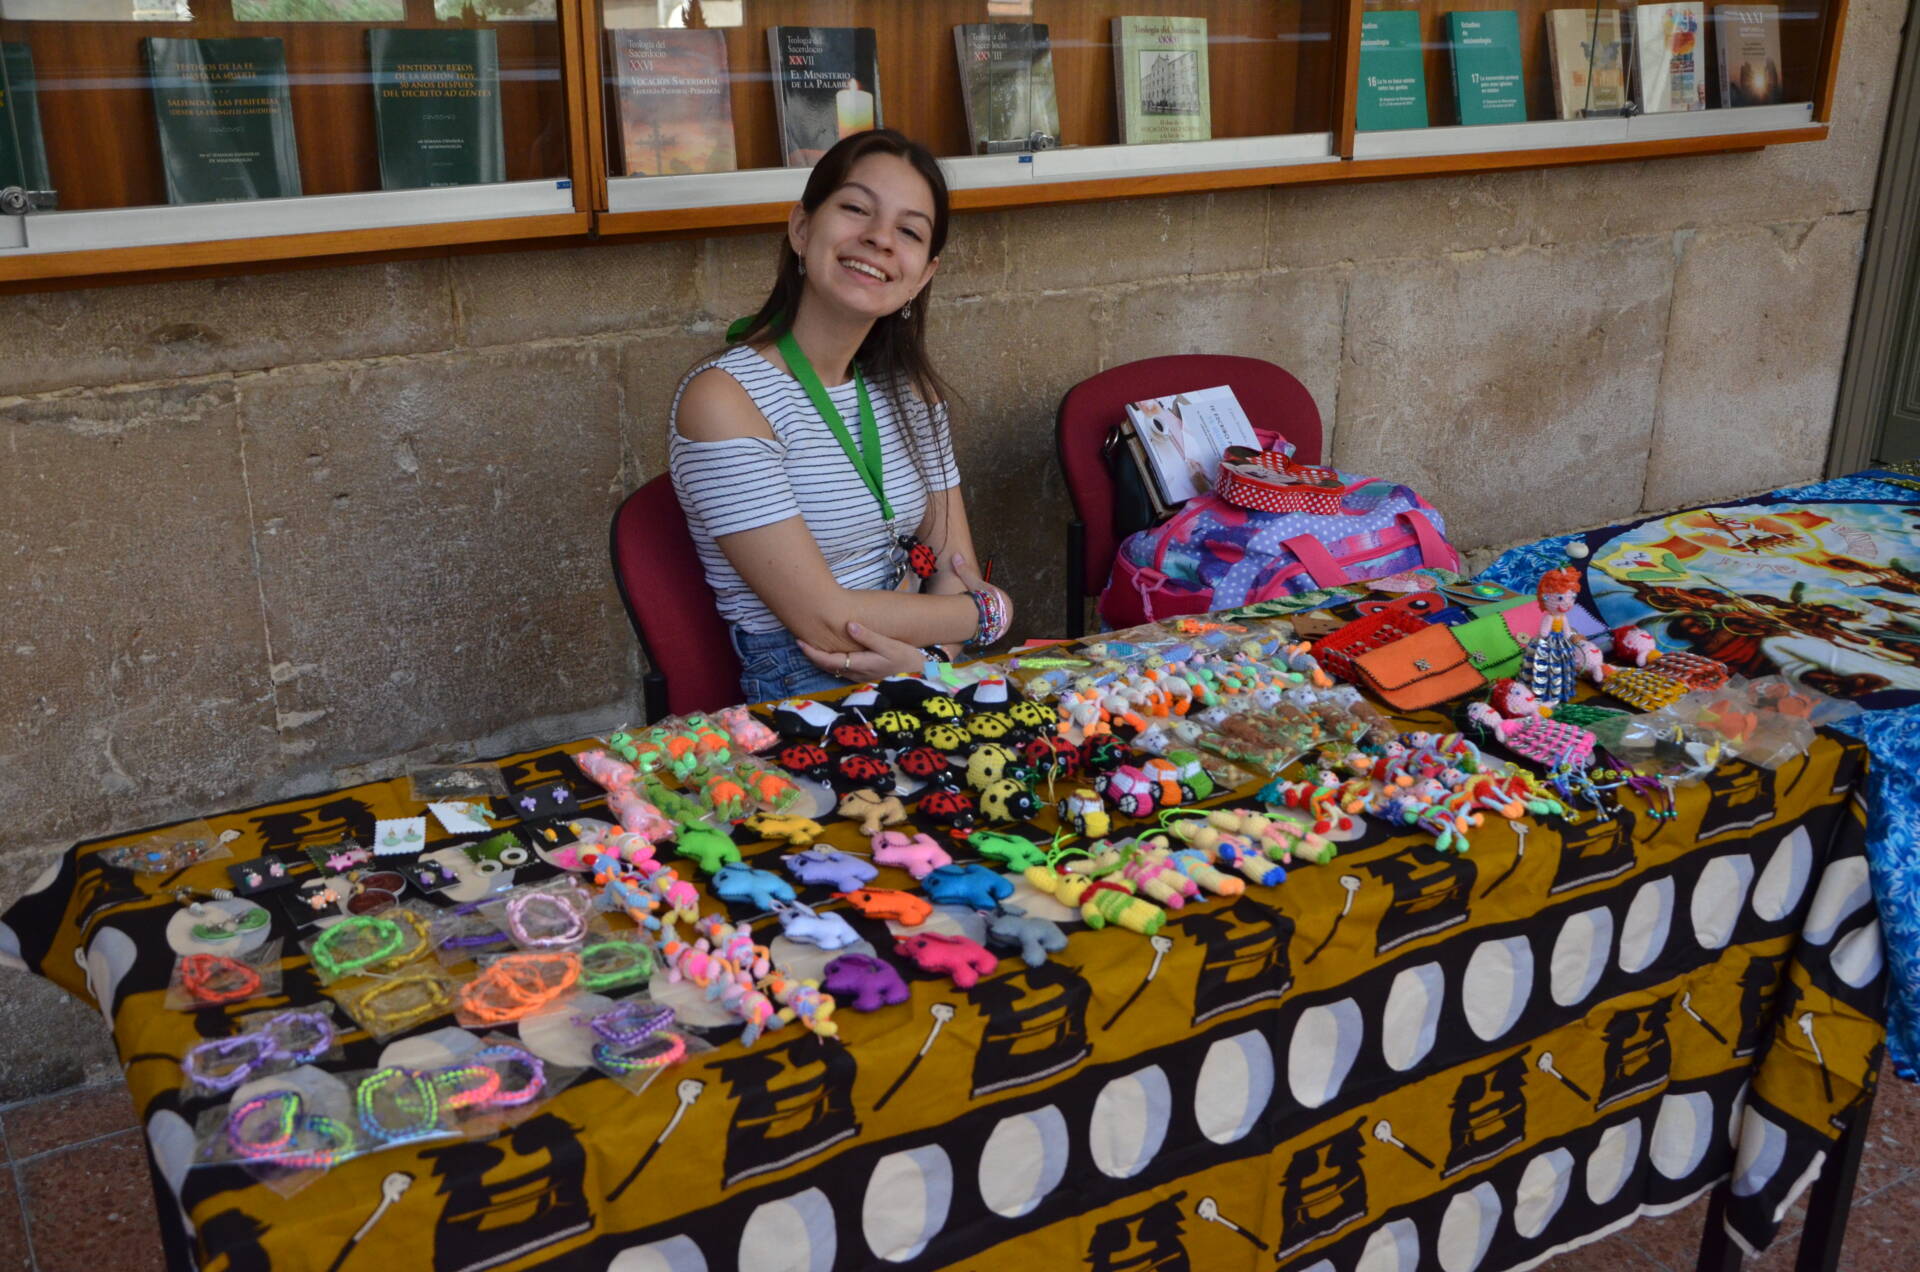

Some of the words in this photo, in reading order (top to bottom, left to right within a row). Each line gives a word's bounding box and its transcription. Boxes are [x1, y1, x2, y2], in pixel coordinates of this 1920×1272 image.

[788, 45, 823, 55] Sacerdocio
[630, 59, 653, 72] XXVI
[789, 55, 815, 66] XXVII
[396, 63, 437, 71] SENTIDO
[446, 63, 473, 71] RETOS
[395, 72, 404, 80] DE
[409, 72, 420, 80] LA
[1472, 73, 1480, 84] 17
[1368, 76, 1377, 87] 16
[383, 90, 400, 98] DEL
[401, 90, 442, 98] DECRETO
[445, 89, 457, 97] AD
[219, 98, 233, 106] LAS
